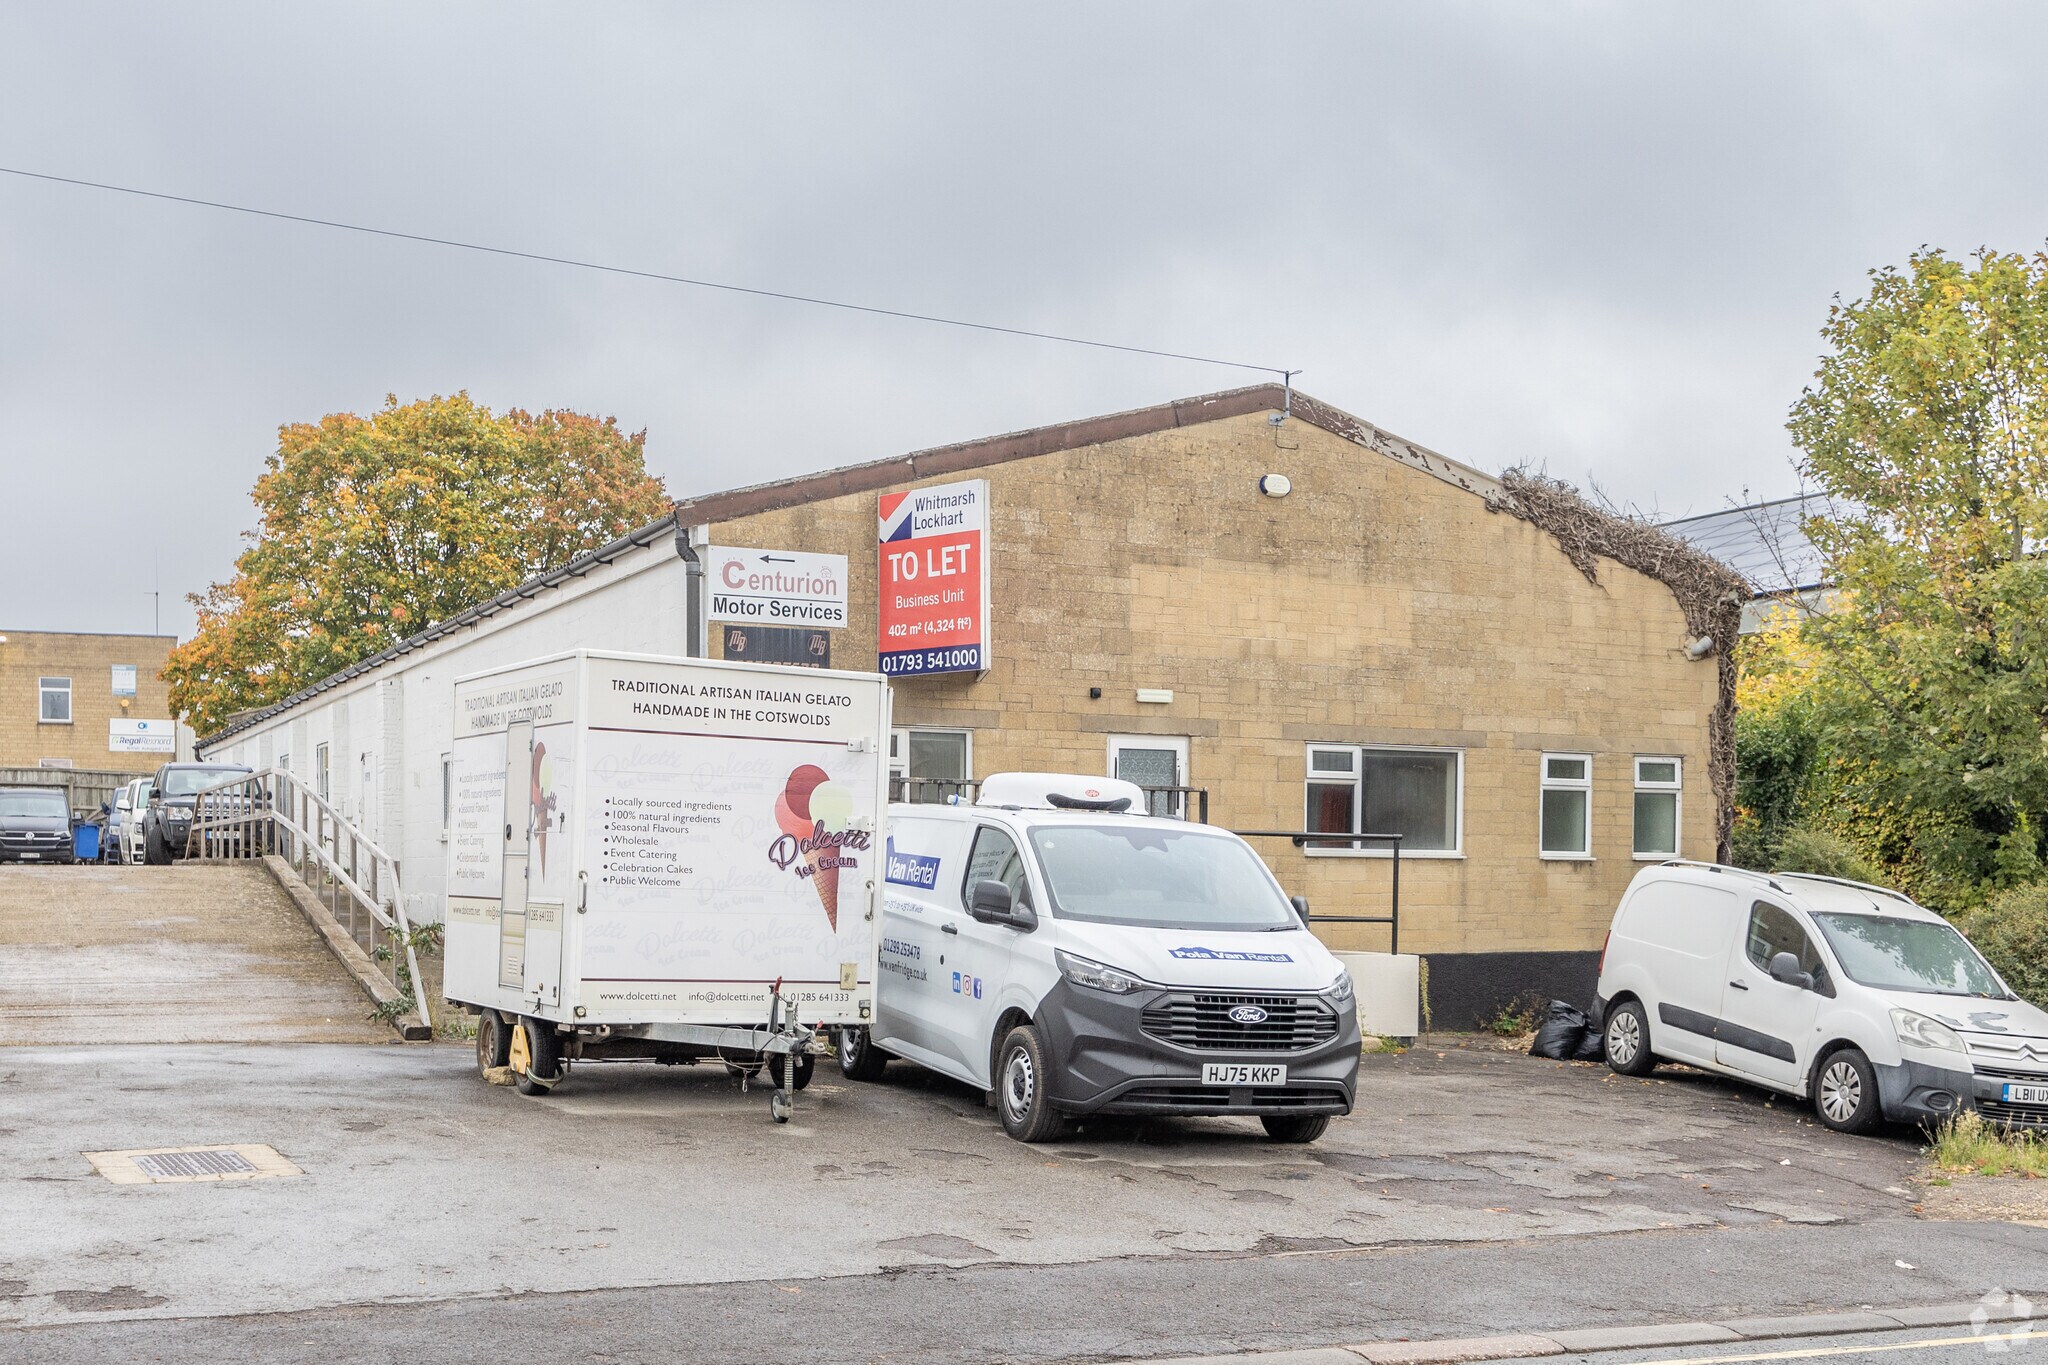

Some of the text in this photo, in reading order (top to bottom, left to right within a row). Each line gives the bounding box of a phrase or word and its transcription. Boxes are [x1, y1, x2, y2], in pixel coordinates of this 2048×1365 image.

[915, 490, 975, 512] Whitmarsh
[914, 510, 963, 530] Lockhart
[888, 544, 970, 582] TO LET
[722, 561, 837, 596] Centurion
[714, 596, 842, 620] Motor Services
[896, 588, 964, 609] Business Unit
[888, 616, 972, 636] 402 m² (4,324 ft²)
[882, 649, 978, 672] 01793 541000
[464, 681, 562, 712] TRADITIONAL ARTISAN ITALIAN GELATO
[612, 680, 852, 707] TRADITIONAL ARTISAN ITALIAN GELATO
[471, 712, 500, 729] HANDMADE
[508, 709, 517, 720] THE
[518, 704, 552, 720] COTSWOLDS
[633, 702, 830, 726] HANDMADE IN THE COTSWOLDS
[612, 796, 732, 811] Locally sourced ingredients
[612, 810, 720, 824] 100% natural ingredients
[611, 822, 689, 834] Seasonal Flavours
[610, 835, 658, 846] Wholesale
[768, 819, 870, 871] Dolcetti
[610, 848, 677, 862] Event Catering
[610, 862, 693, 874] Celebration Cakes
[795, 856, 858, 879] Ice Cream
[888, 856, 936, 885] Van Rental
[609, 876, 681, 886] Public Welcome
[539, 910, 554, 922] 641333
[883, 938, 920, 960] 01299 253478
[1175, 951, 1287, 962] Pola Van Rental
[878, 960, 928, 981] ww.vanfridge.co.uk
[600, 992, 676, 1001] www.dolcetti.net
[688, 992, 765, 1003] info@dolcetti.net
[790, 992, 816, 1001] 01285
[819, 993, 849, 1002] 641333
[1235, 1008, 1261, 1021] Ford
[1209, 1066, 1280, 1083] HJ75 KKP
[2015, 1088, 2036, 1101] LB11
